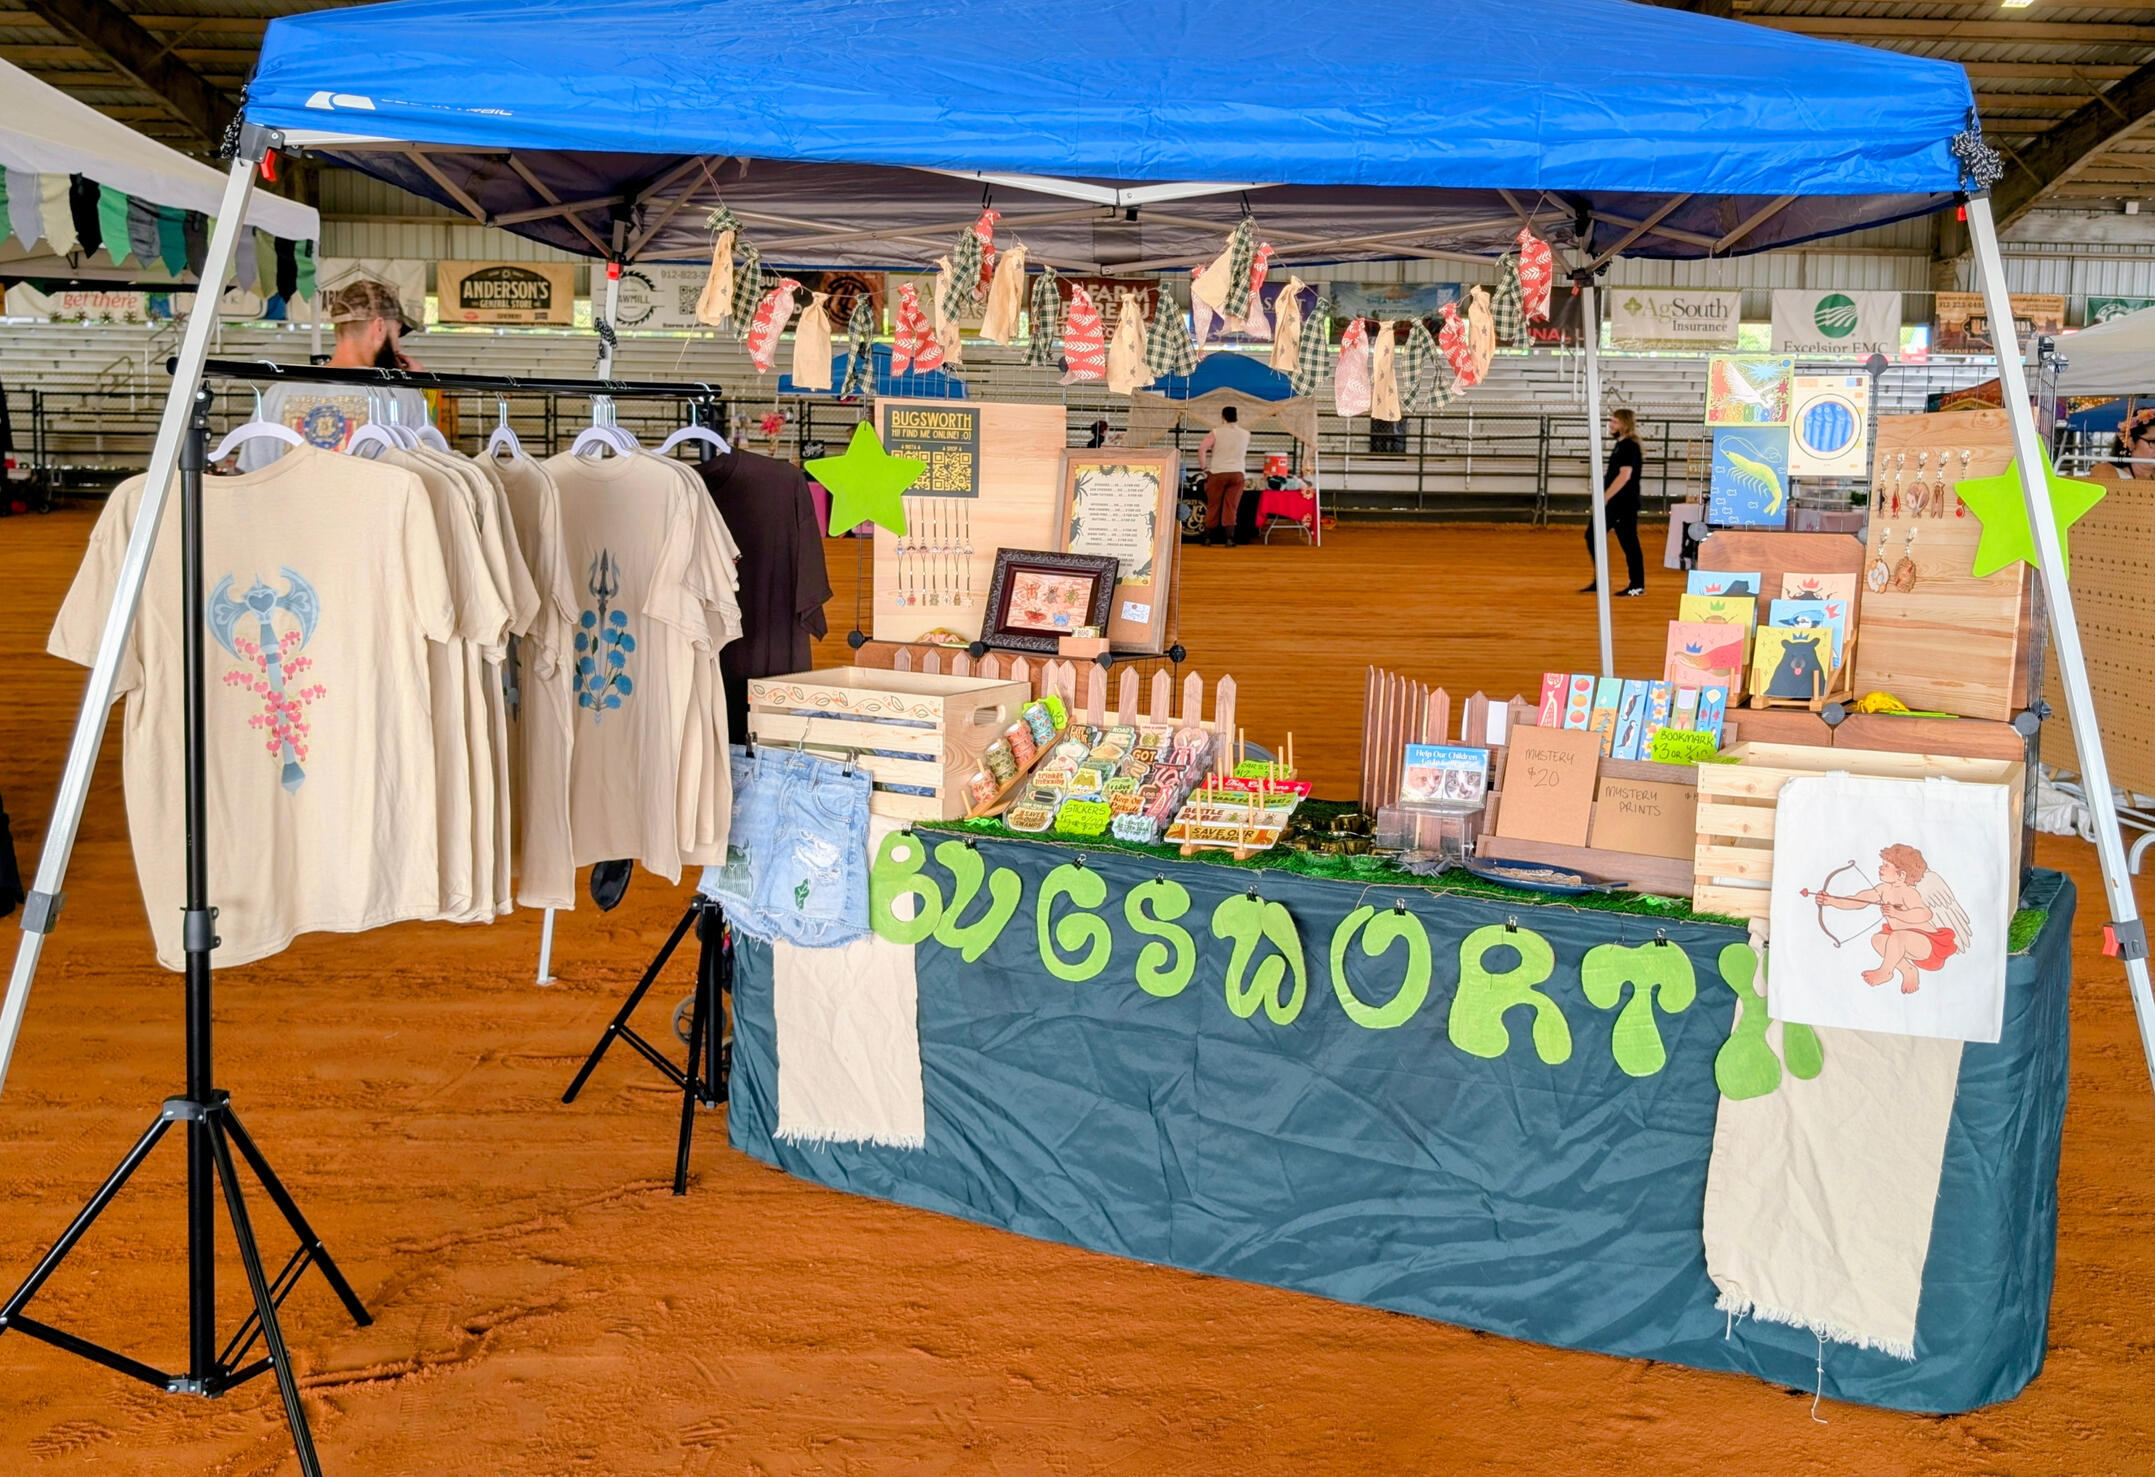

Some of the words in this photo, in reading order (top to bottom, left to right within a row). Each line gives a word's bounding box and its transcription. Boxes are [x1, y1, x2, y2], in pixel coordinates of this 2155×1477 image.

[463, 280, 549, 299] ANDERSON'S
[480, 299, 510, 308] GENERAL
[511, 300, 533, 308] STORE
[1641, 297, 1729, 324] AgSouth
[1672, 320, 1728, 333] Insurance
[1783, 340, 1849, 352] Excelsior
[892, 410, 972, 428] BUGSWORTH
[902, 429, 918, 438] FIND
[920, 430, 931, 438] ME
[932, 431, 959, 440] ONLINE!
[1660, 730, 1714, 747] BOOKMARK
[1132, 749, 1157, 762] GOT
[1415, 749, 1432, 758] Help
[1525, 748, 1576, 764] MYSTERY
[1527, 766, 1561, 788] $20
[1605, 786, 1658, 801] MYSTERY
[1065, 803, 1106, 815] STICKERS
[1619, 801, 1662, 817] PRINTS
[1193, 827, 1225, 837] SAVE
